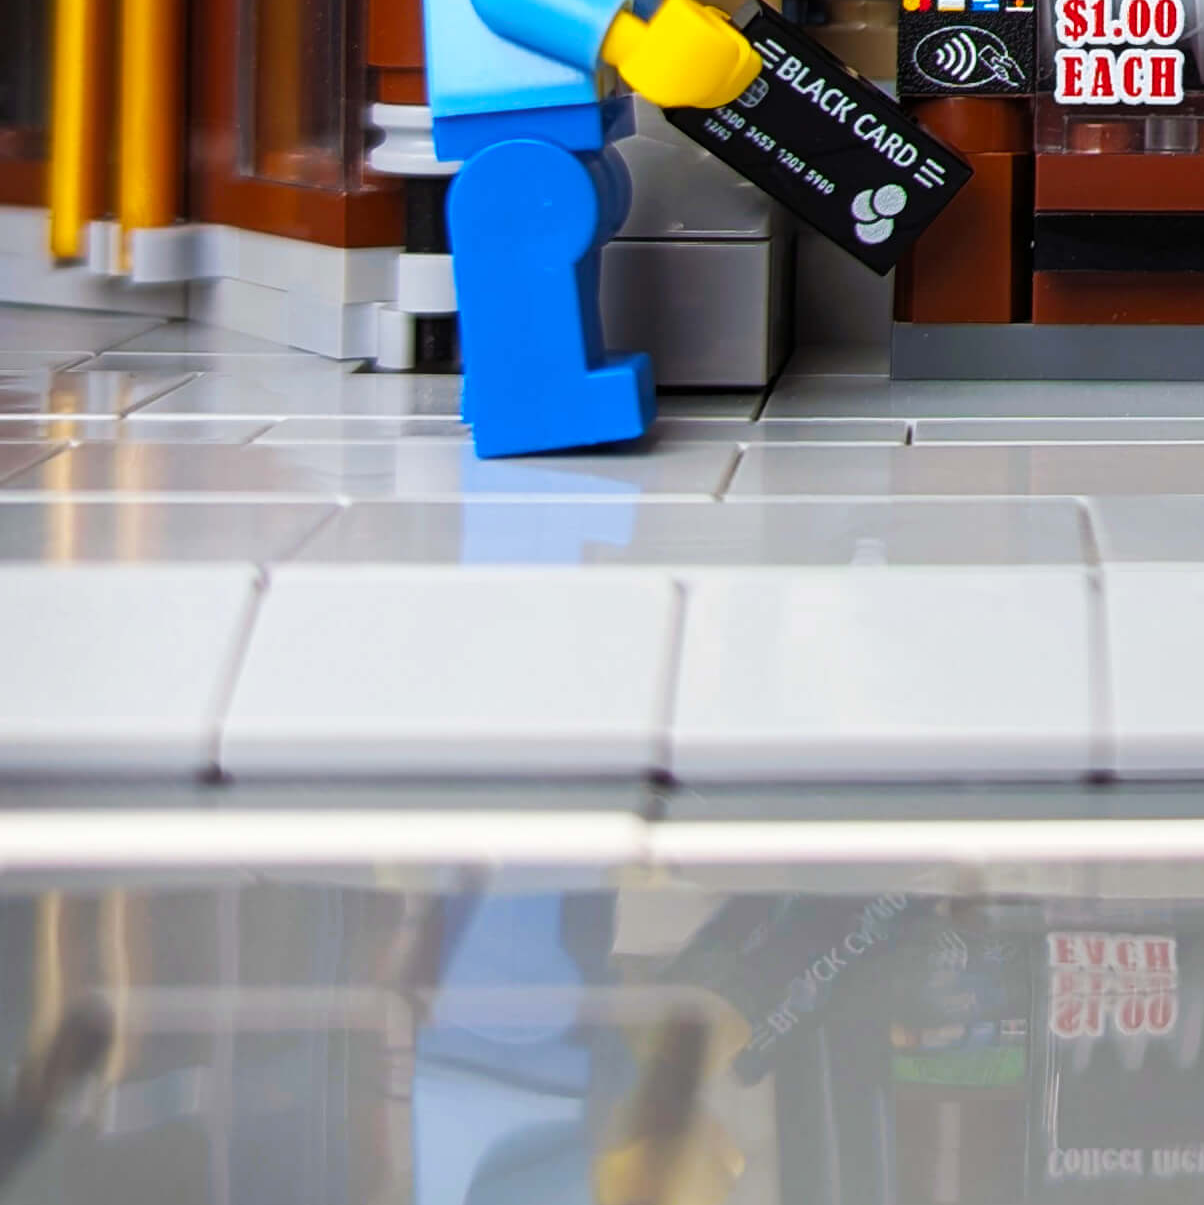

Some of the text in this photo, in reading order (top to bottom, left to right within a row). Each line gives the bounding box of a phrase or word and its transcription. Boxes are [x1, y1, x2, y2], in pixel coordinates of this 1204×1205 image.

[774, 56, 919, 169] BLACK CARD
[1061, 56, 1178, 97] EACH
